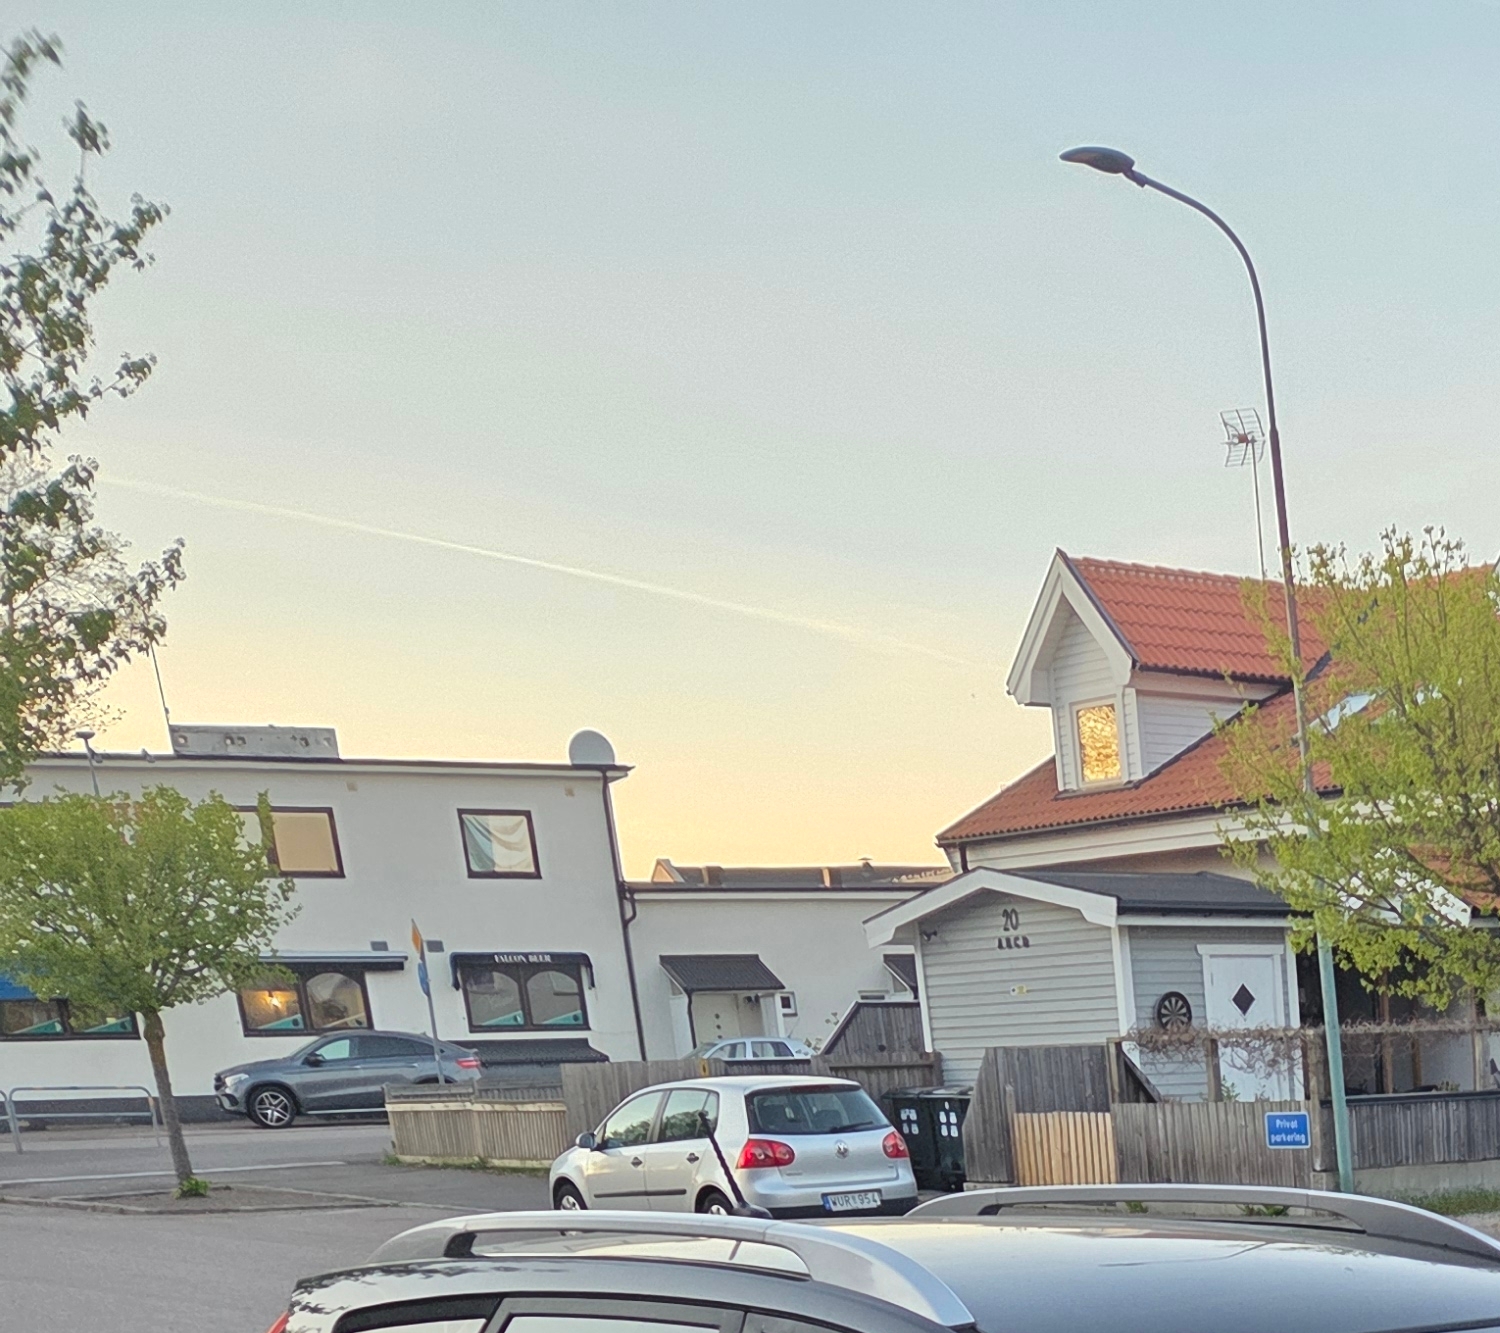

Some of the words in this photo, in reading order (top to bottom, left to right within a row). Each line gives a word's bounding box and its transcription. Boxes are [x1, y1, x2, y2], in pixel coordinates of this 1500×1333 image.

[1002, 908, 1019, 931] 20
[1275, 1119, 1298, 1129] Privat
[1271, 1132, 1306, 1144] parkering
